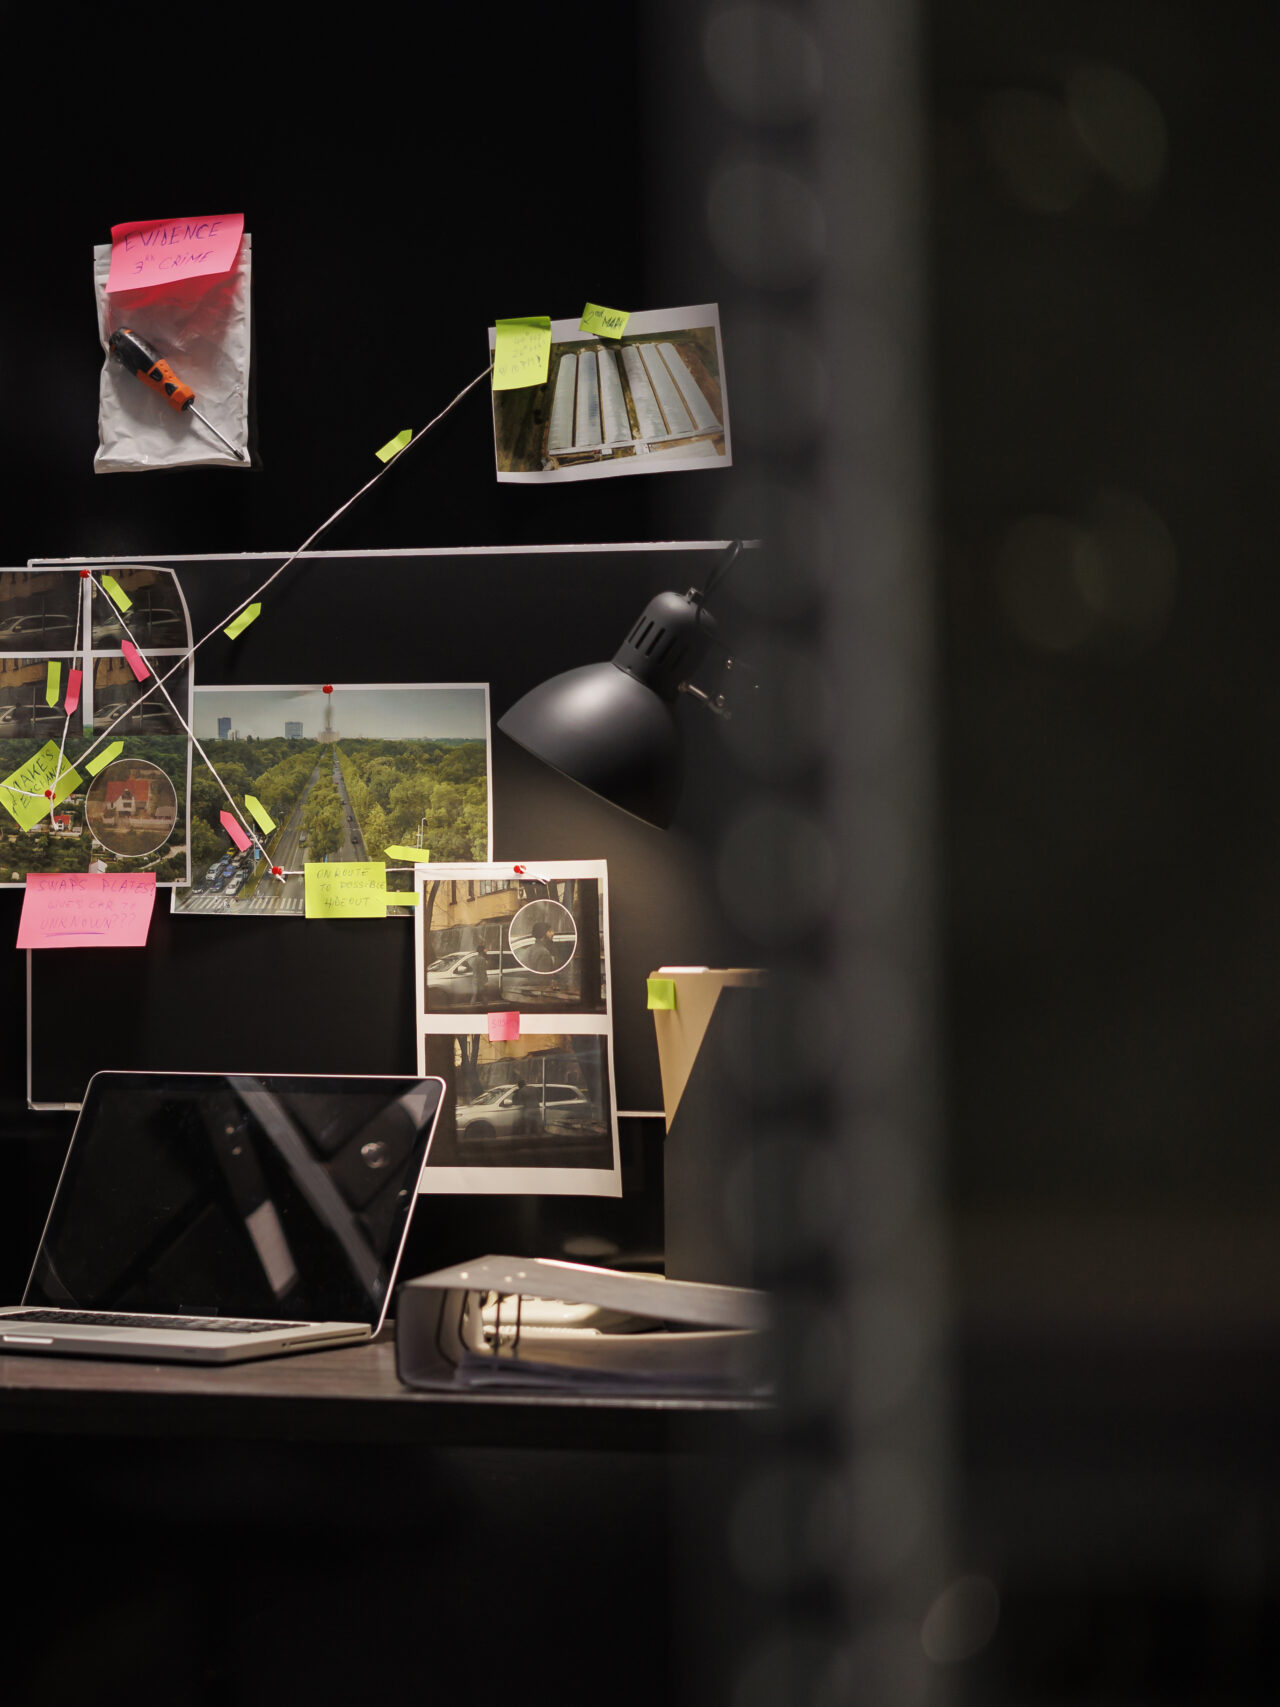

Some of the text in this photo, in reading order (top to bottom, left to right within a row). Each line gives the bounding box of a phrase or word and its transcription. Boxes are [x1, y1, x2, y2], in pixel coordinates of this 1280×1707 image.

[123, 221, 223, 252] EVIDENCE
[158, 250, 215, 270] CRIME
[38, 878, 88, 893] SWAPS
